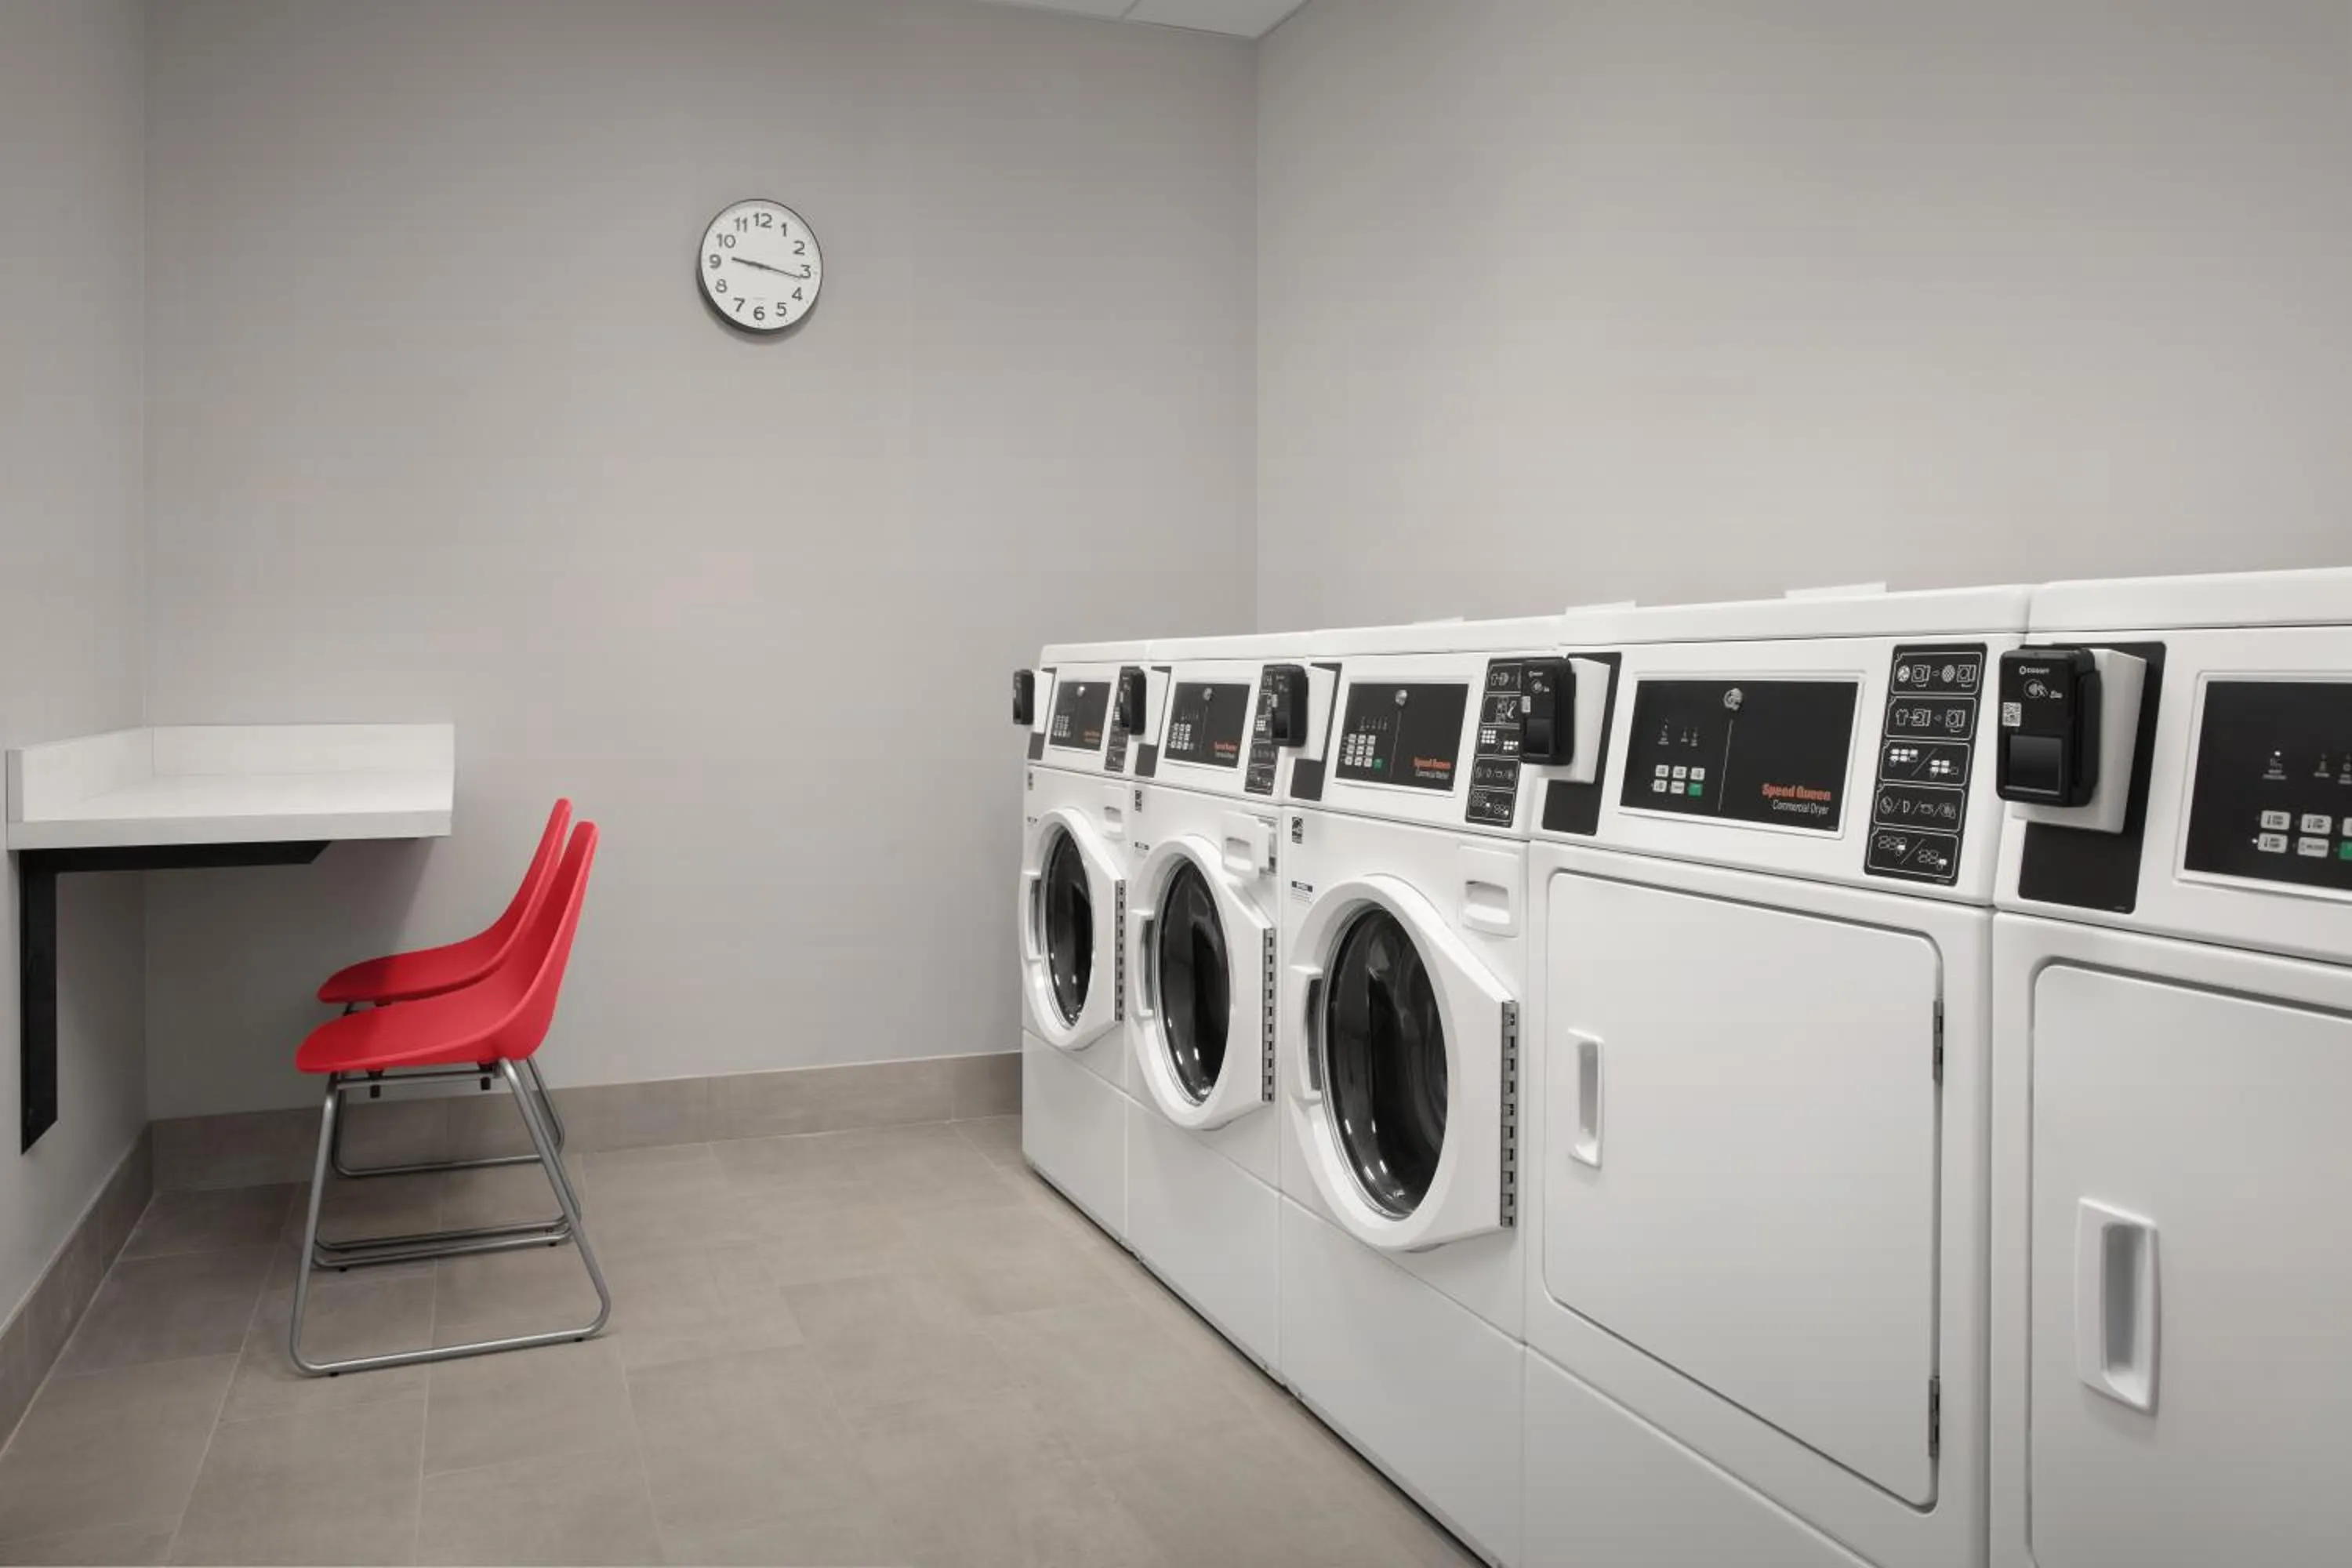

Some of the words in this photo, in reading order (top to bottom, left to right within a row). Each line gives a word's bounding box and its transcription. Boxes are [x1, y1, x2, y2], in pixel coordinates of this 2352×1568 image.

[734, 217, 748, 233] 11
[753, 212, 772, 228] 12
[781, 222, 787, 237] 1
[717, 233, 736, 249] 10
[793, 240, 805, 256] 2
[709, 254, 722, 269] 9
[800, 264, 811, 278] 3
[715, 278, 728, 293] 8
[791, 287, 804, 301] 4
[733, 297, 746, 312] 7
[775, 302, 787, 317] 5
[753, 306, 765, 321] 6
[1762, 782, 1796, 799] Speed
[1797, 786, 1831, 800] Queen
[1773, 799, 1810, 813] Commercial
[1810, 802, 1830, 818] Dryer
